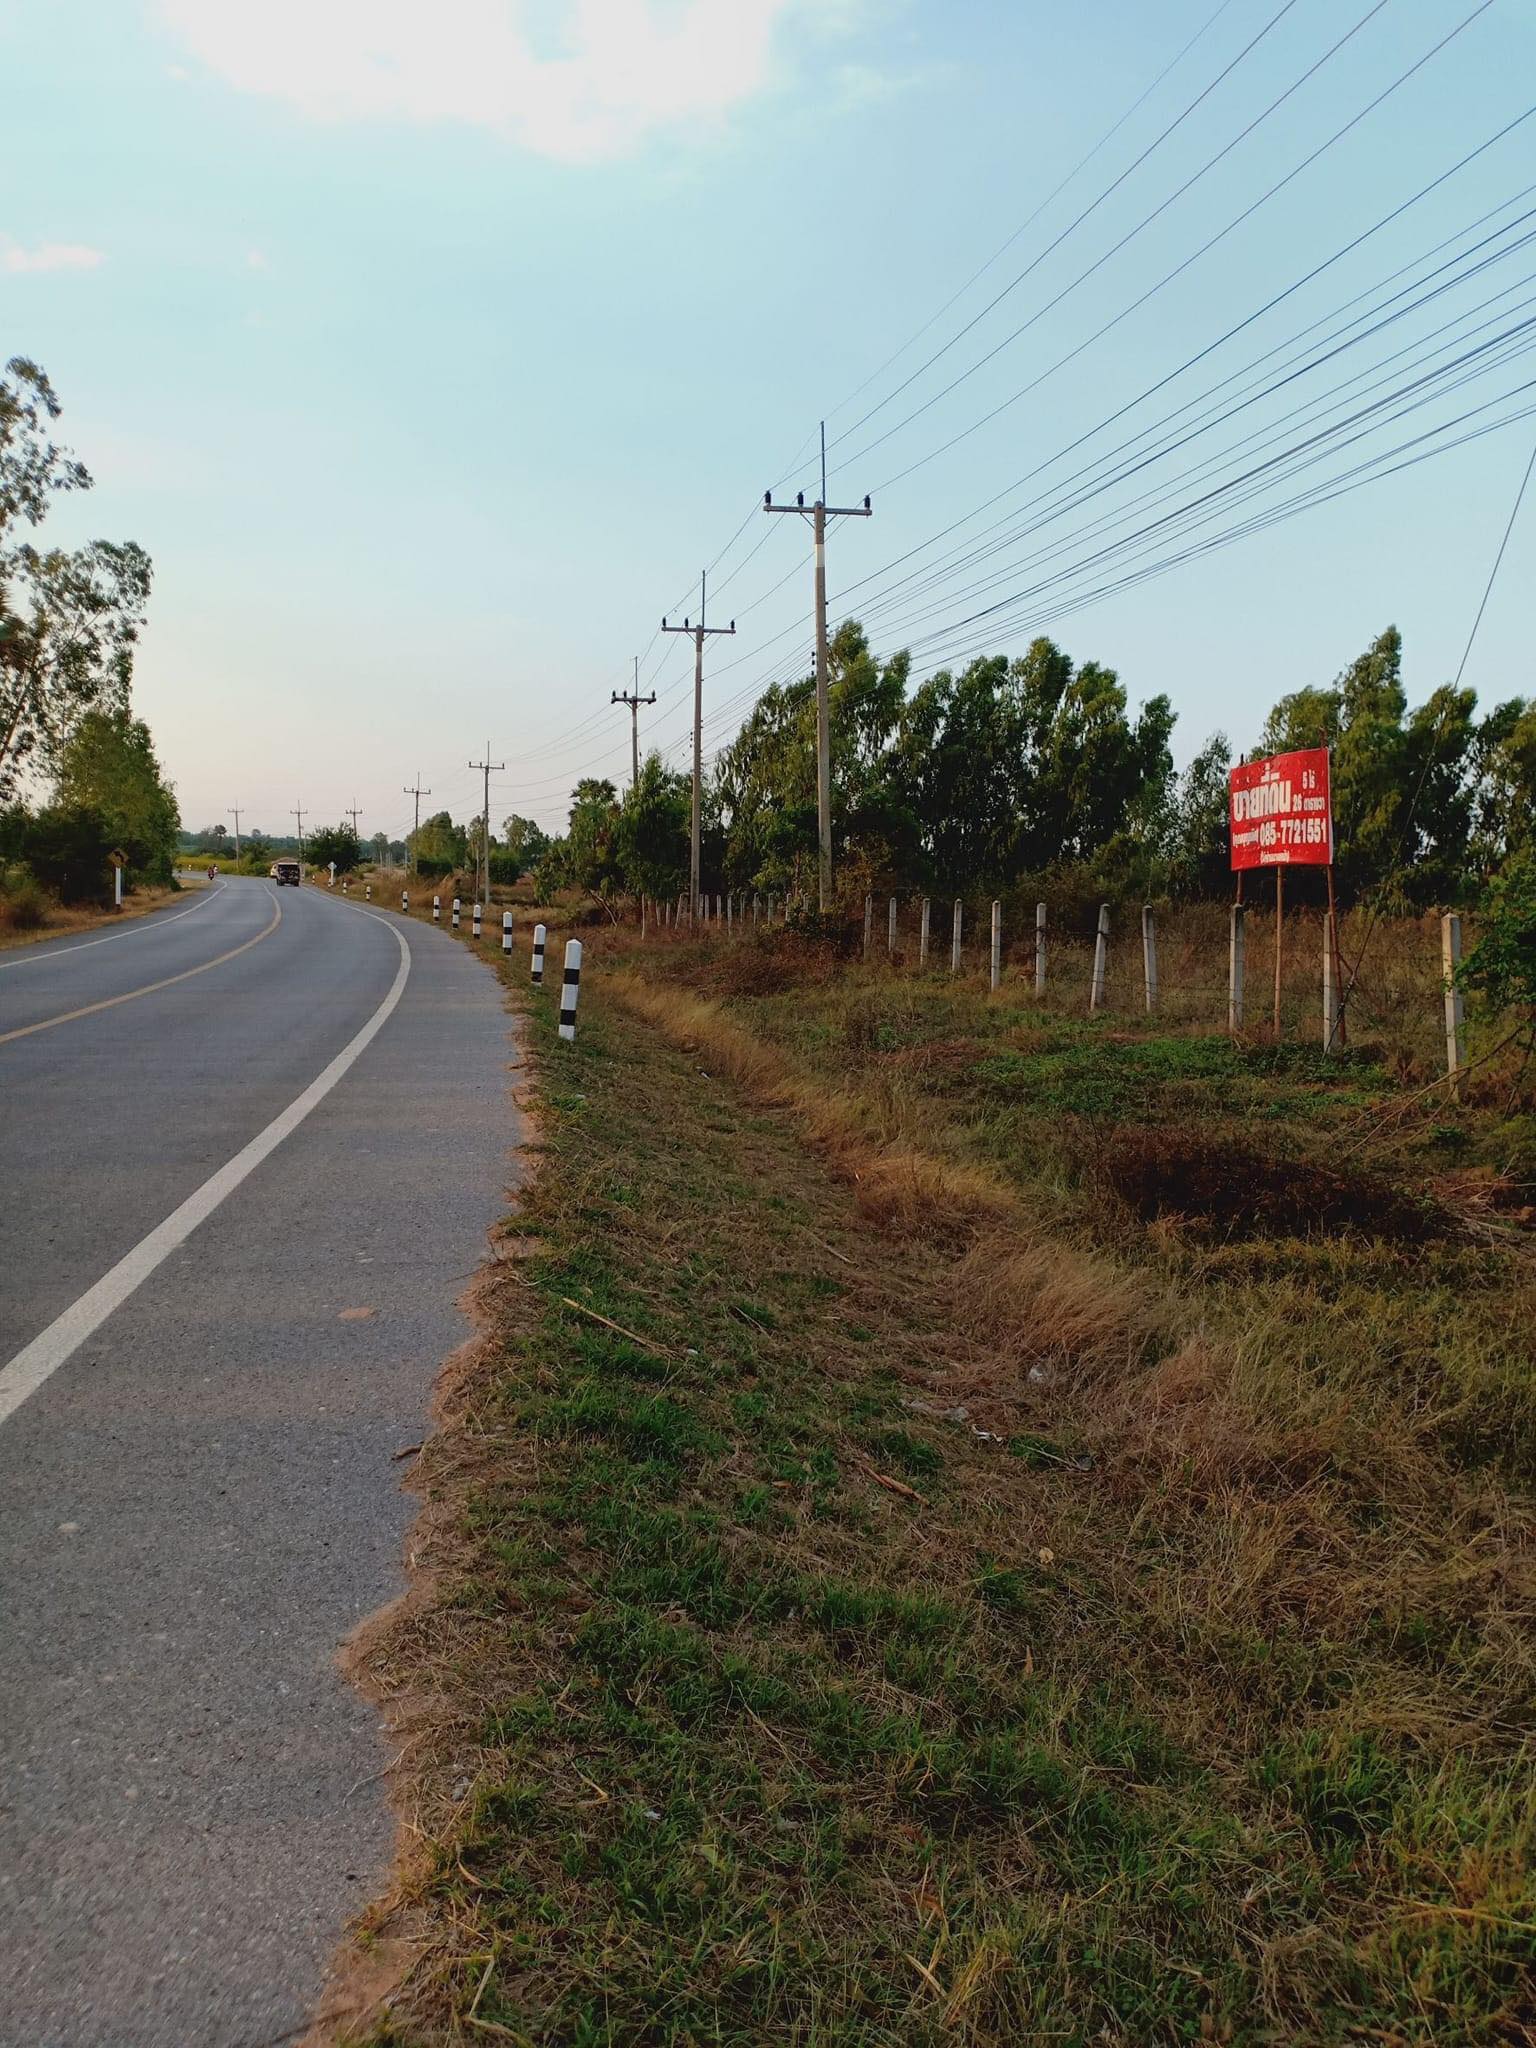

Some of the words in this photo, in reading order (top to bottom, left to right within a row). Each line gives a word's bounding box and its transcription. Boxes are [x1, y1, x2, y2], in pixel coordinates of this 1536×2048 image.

[1233, 763, 1291, 822] ขายที่ดิน
[1260, 817, 1327, 847] 085-7721551
